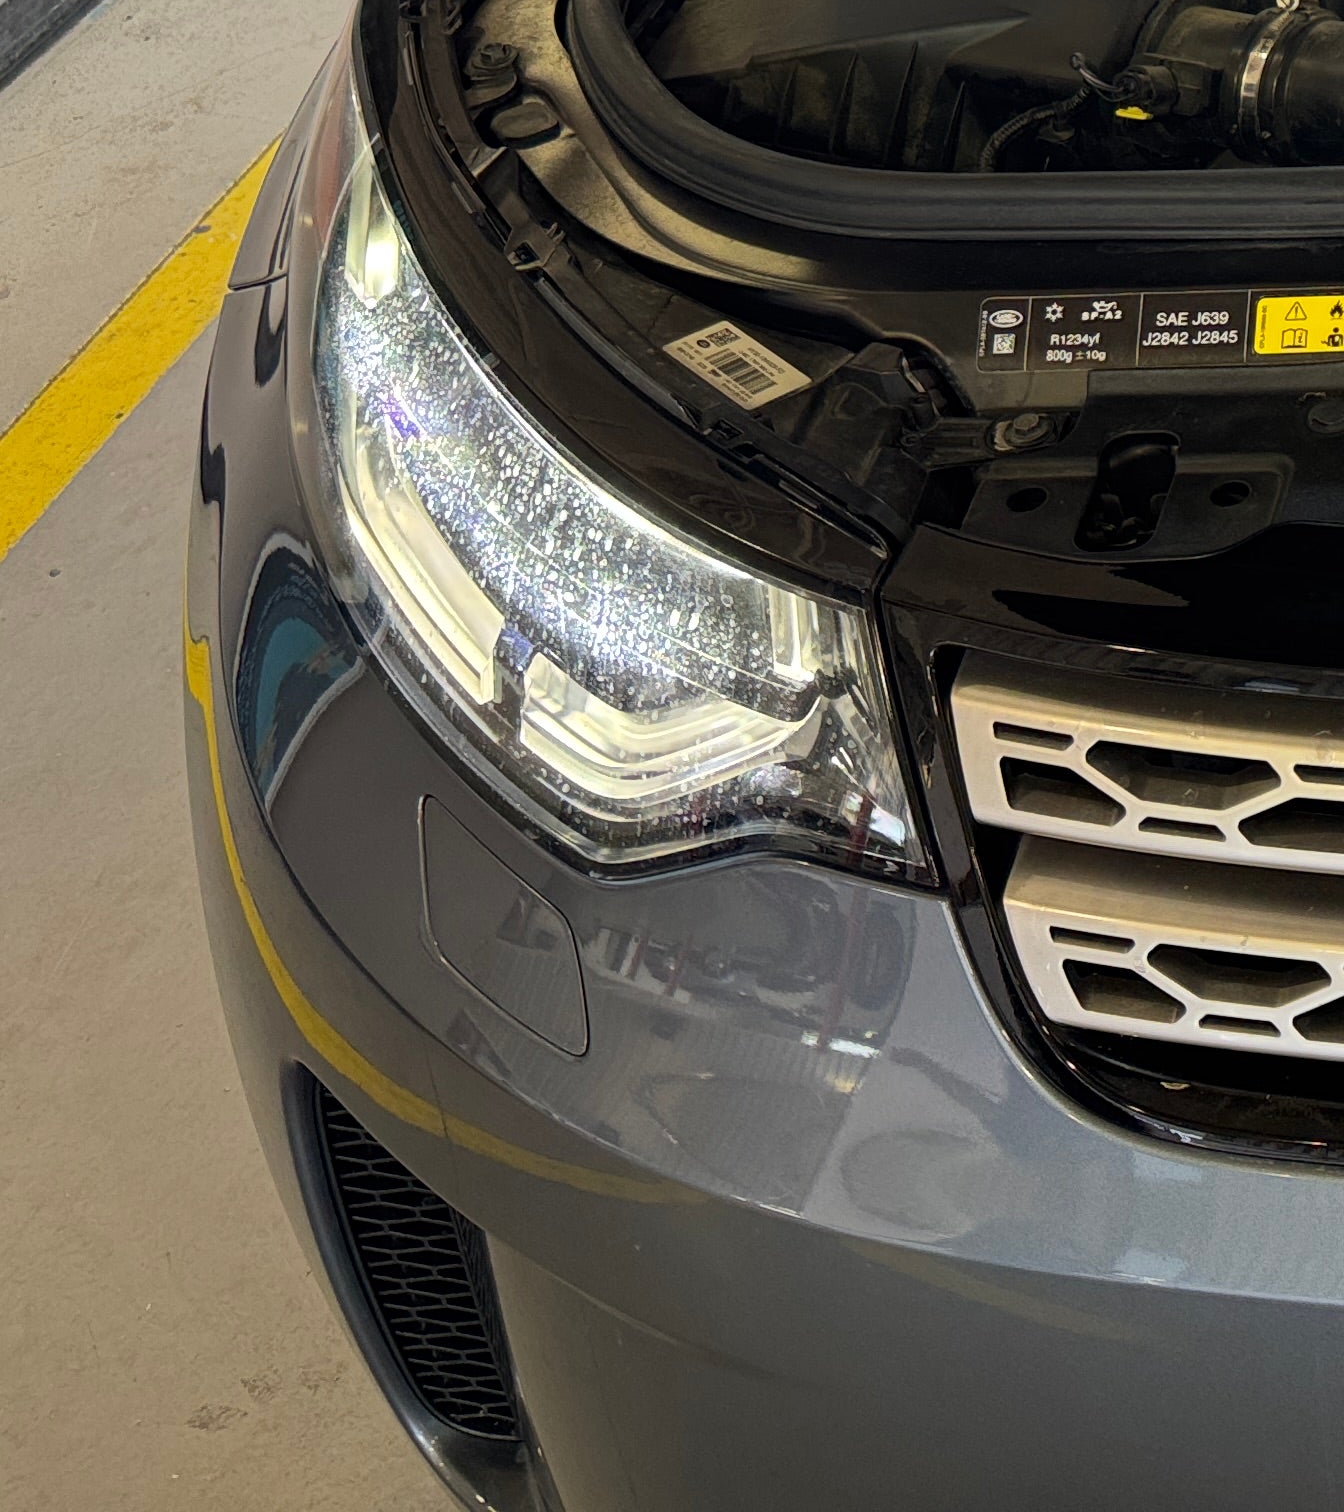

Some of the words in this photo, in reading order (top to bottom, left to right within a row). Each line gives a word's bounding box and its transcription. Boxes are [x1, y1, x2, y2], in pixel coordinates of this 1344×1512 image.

[1156, 312, 1190, 326] SAE
[1191, 311, 1230, 326] J639
[1050, 332, 1101, 347] R1234yf
[1142, 331, 1189, 346] J2842
[1191, 329, 1239, 345] J2845
[1046, 349, 1073, 363] 800g
